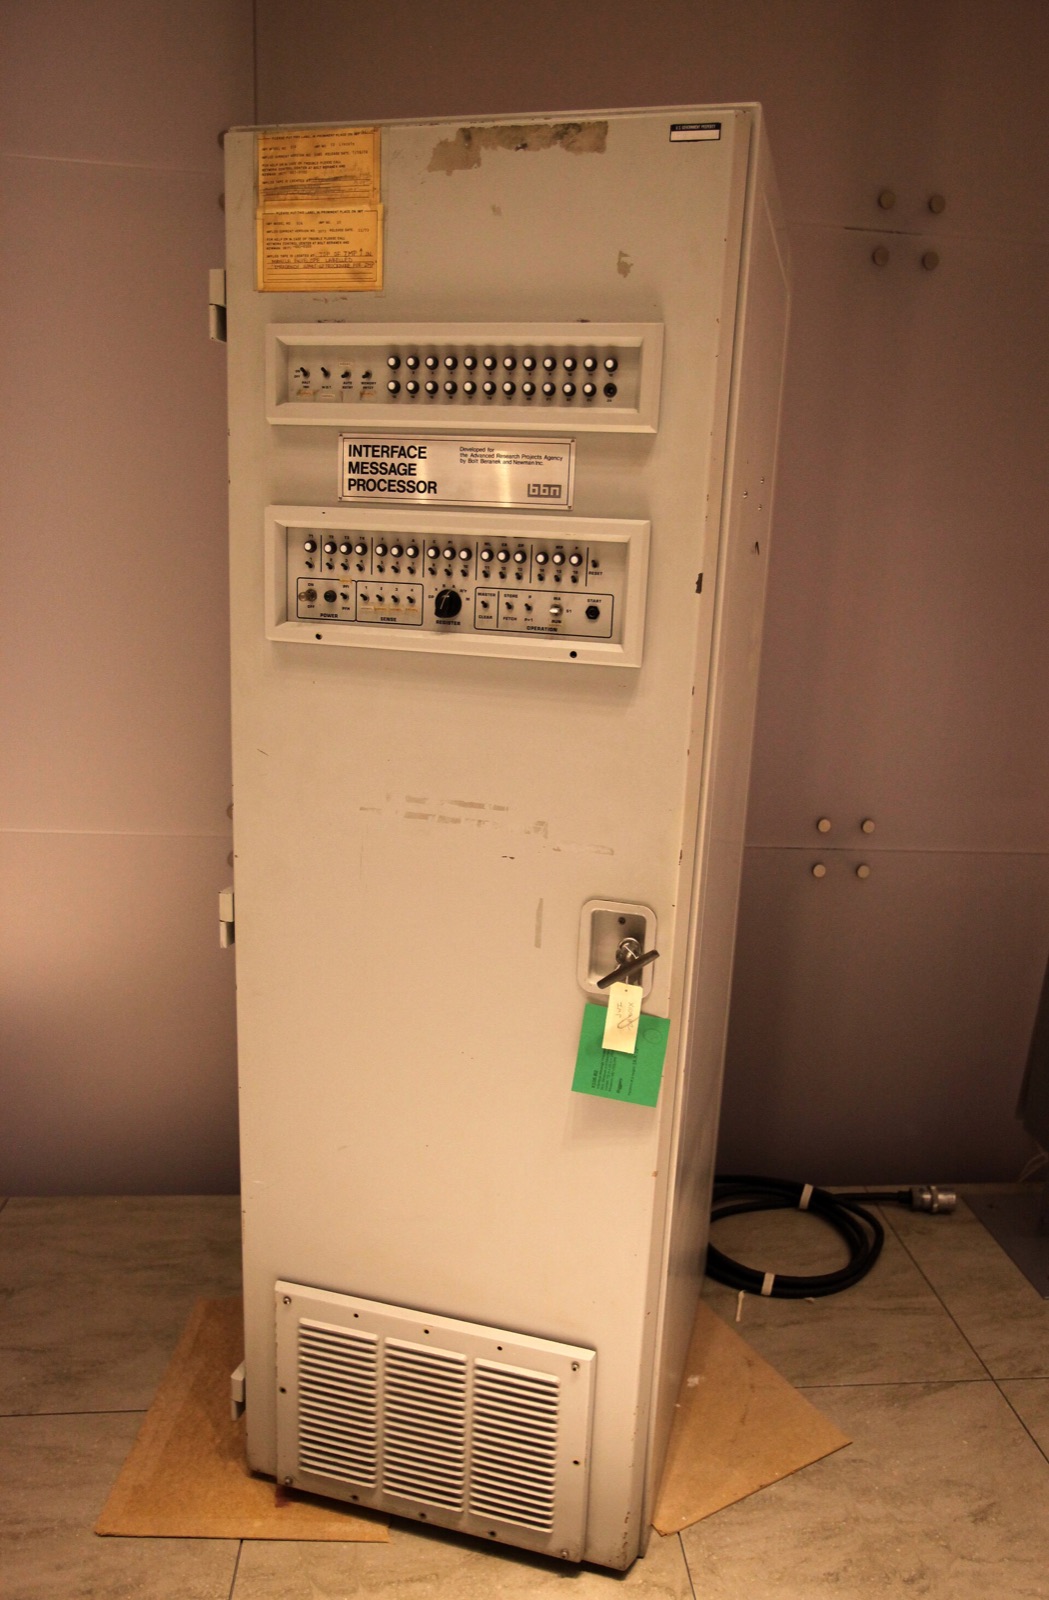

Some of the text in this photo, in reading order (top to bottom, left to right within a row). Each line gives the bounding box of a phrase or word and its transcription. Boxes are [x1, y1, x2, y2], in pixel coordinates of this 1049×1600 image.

[348, 444, 427, 459] INTERFACE
[348, 461, 417, 476] MESSAGE
[348, 478, 437, 494] PROCESSOR
[527, 484, 562, 498] bbn
